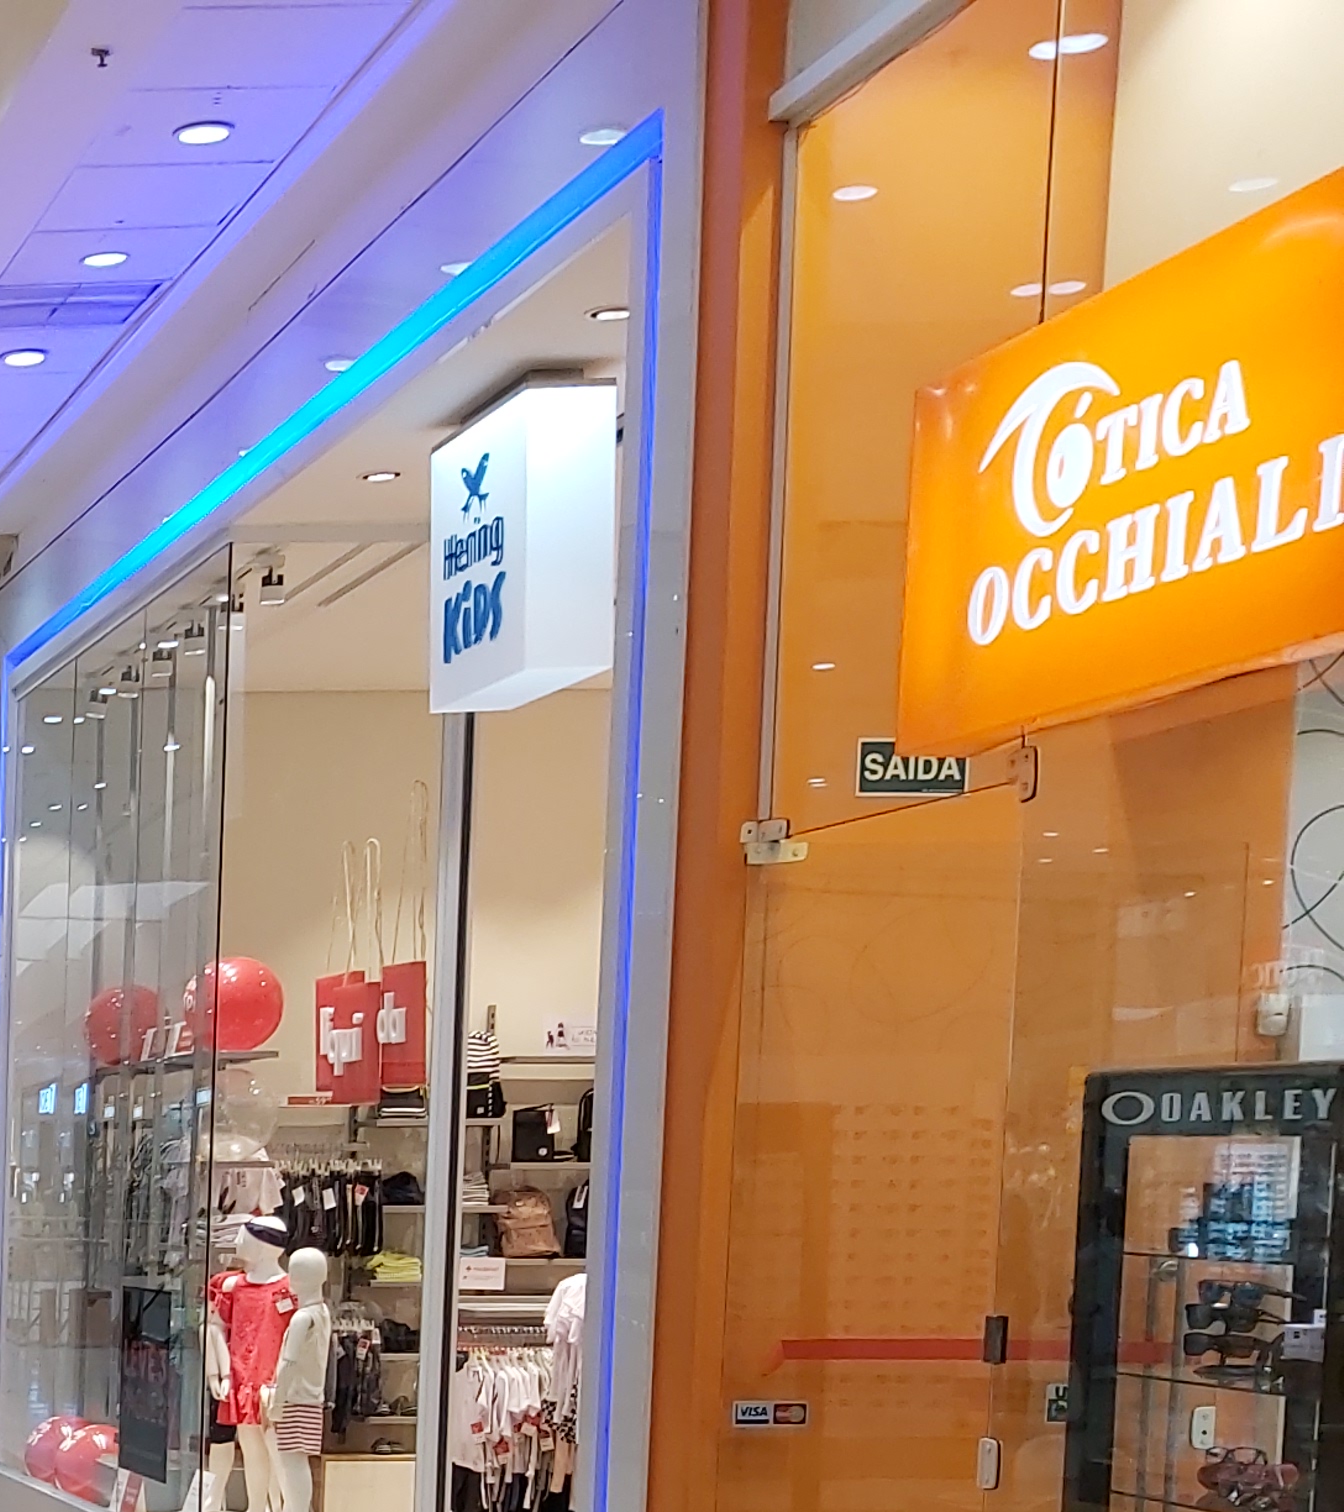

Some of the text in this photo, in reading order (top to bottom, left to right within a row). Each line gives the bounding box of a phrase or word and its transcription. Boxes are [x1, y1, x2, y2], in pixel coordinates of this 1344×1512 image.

[443, 516, 504, 581] Hering
[1162, 1088, 1337, 1123] OAKLEY
[740, 1406, 768, 1417] VISA
